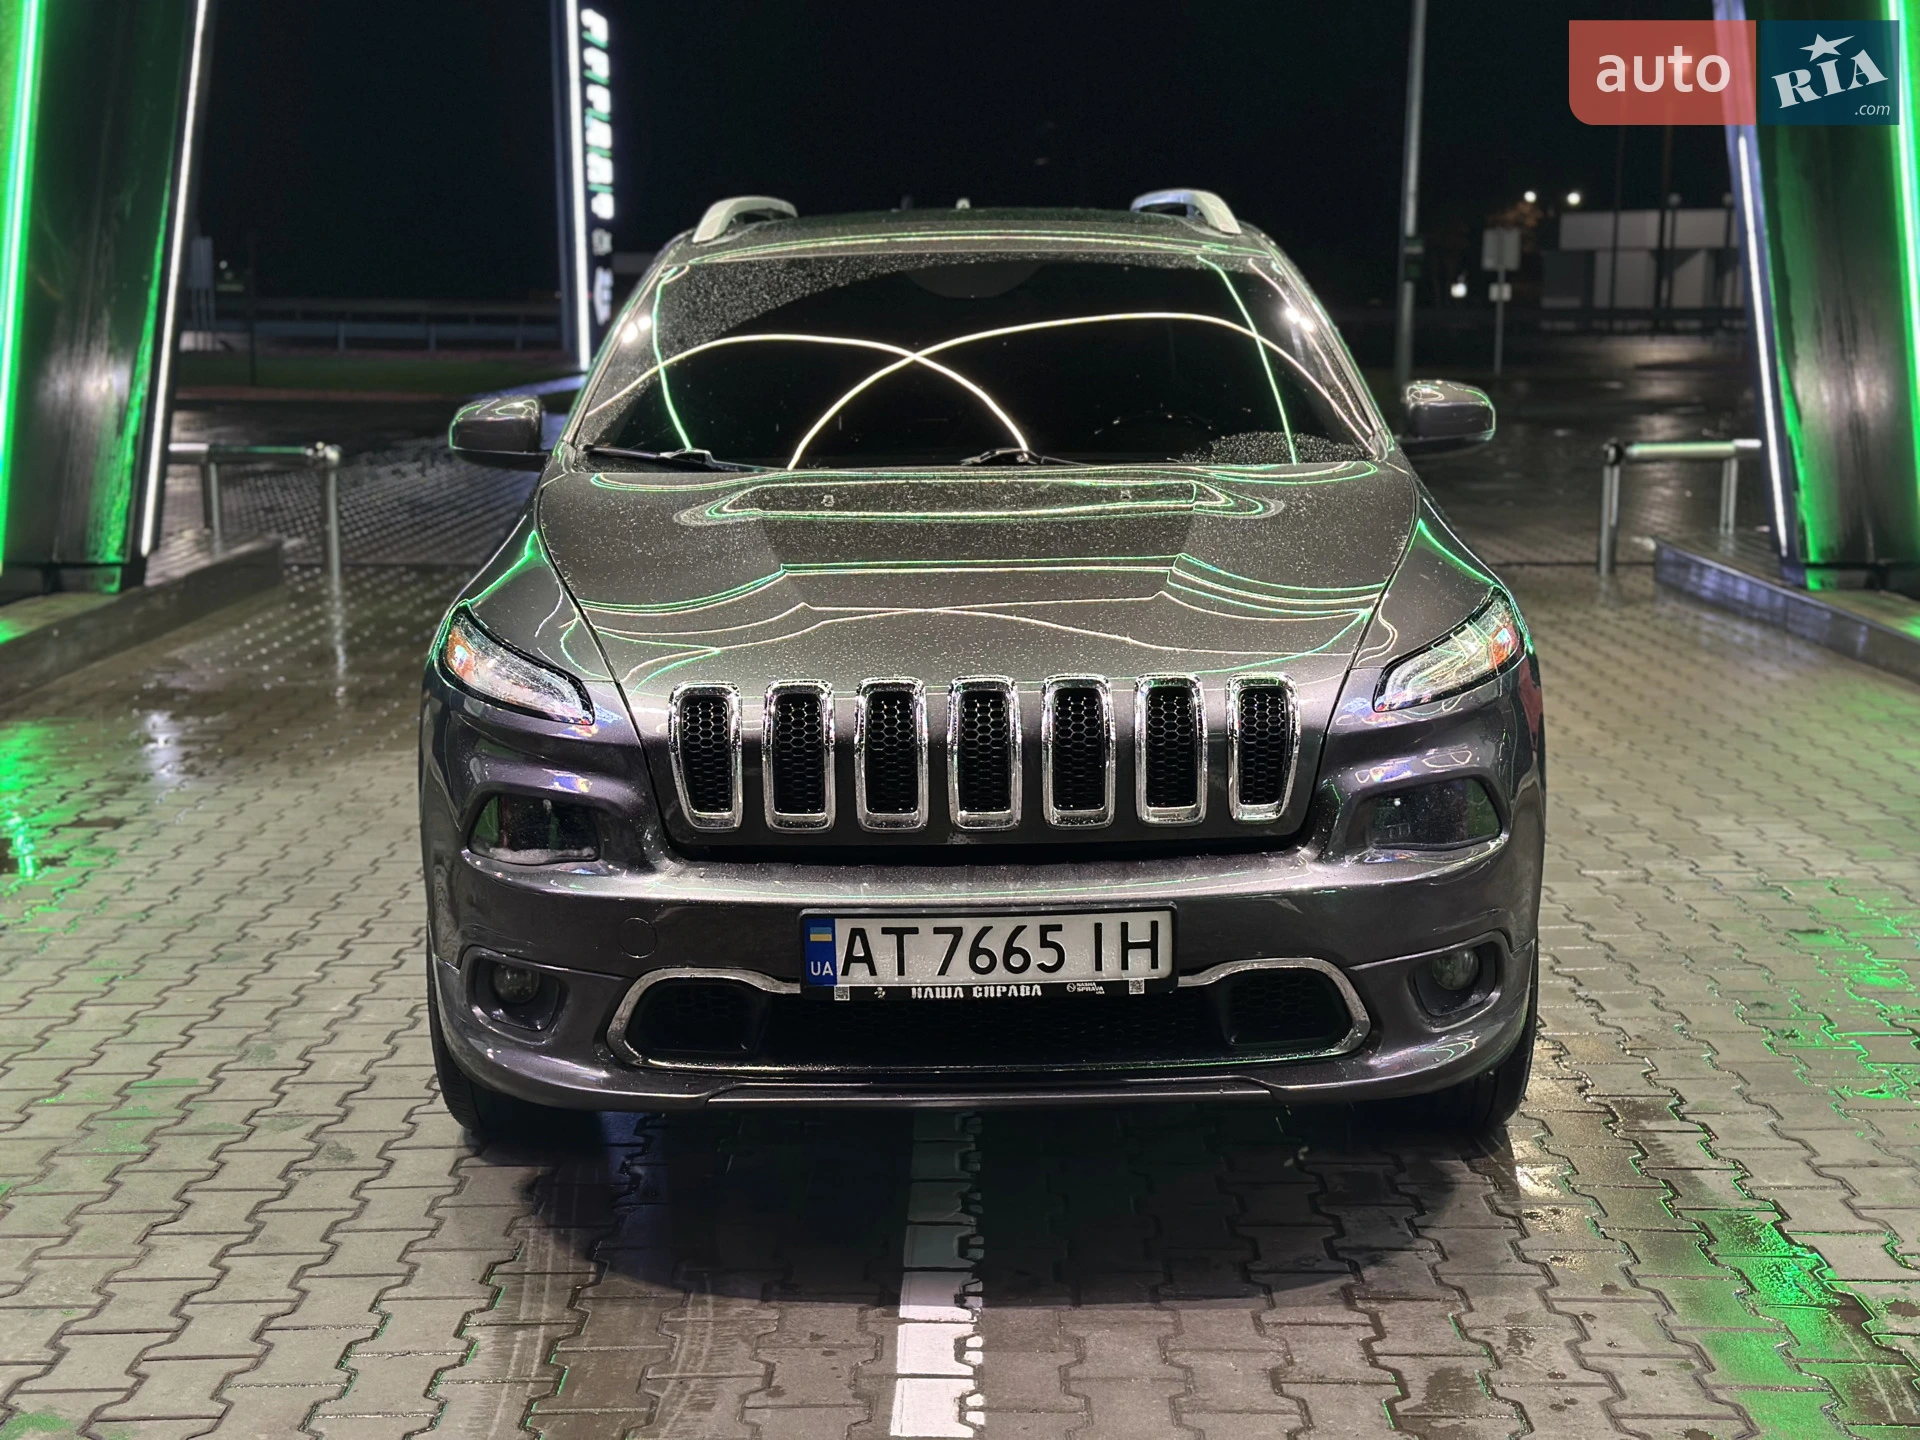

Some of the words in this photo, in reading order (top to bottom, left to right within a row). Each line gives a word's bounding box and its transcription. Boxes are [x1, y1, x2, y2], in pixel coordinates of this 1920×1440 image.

[840, 926, 919, 977] AT
[933, 924, 1066, 975] 7665
[1094, 920, 1159, 972] IH
[810, 961, 834, 976] UA
[911, 986, 964, 999] НАША
[972, 984, 1042, 998] СПРАВА
